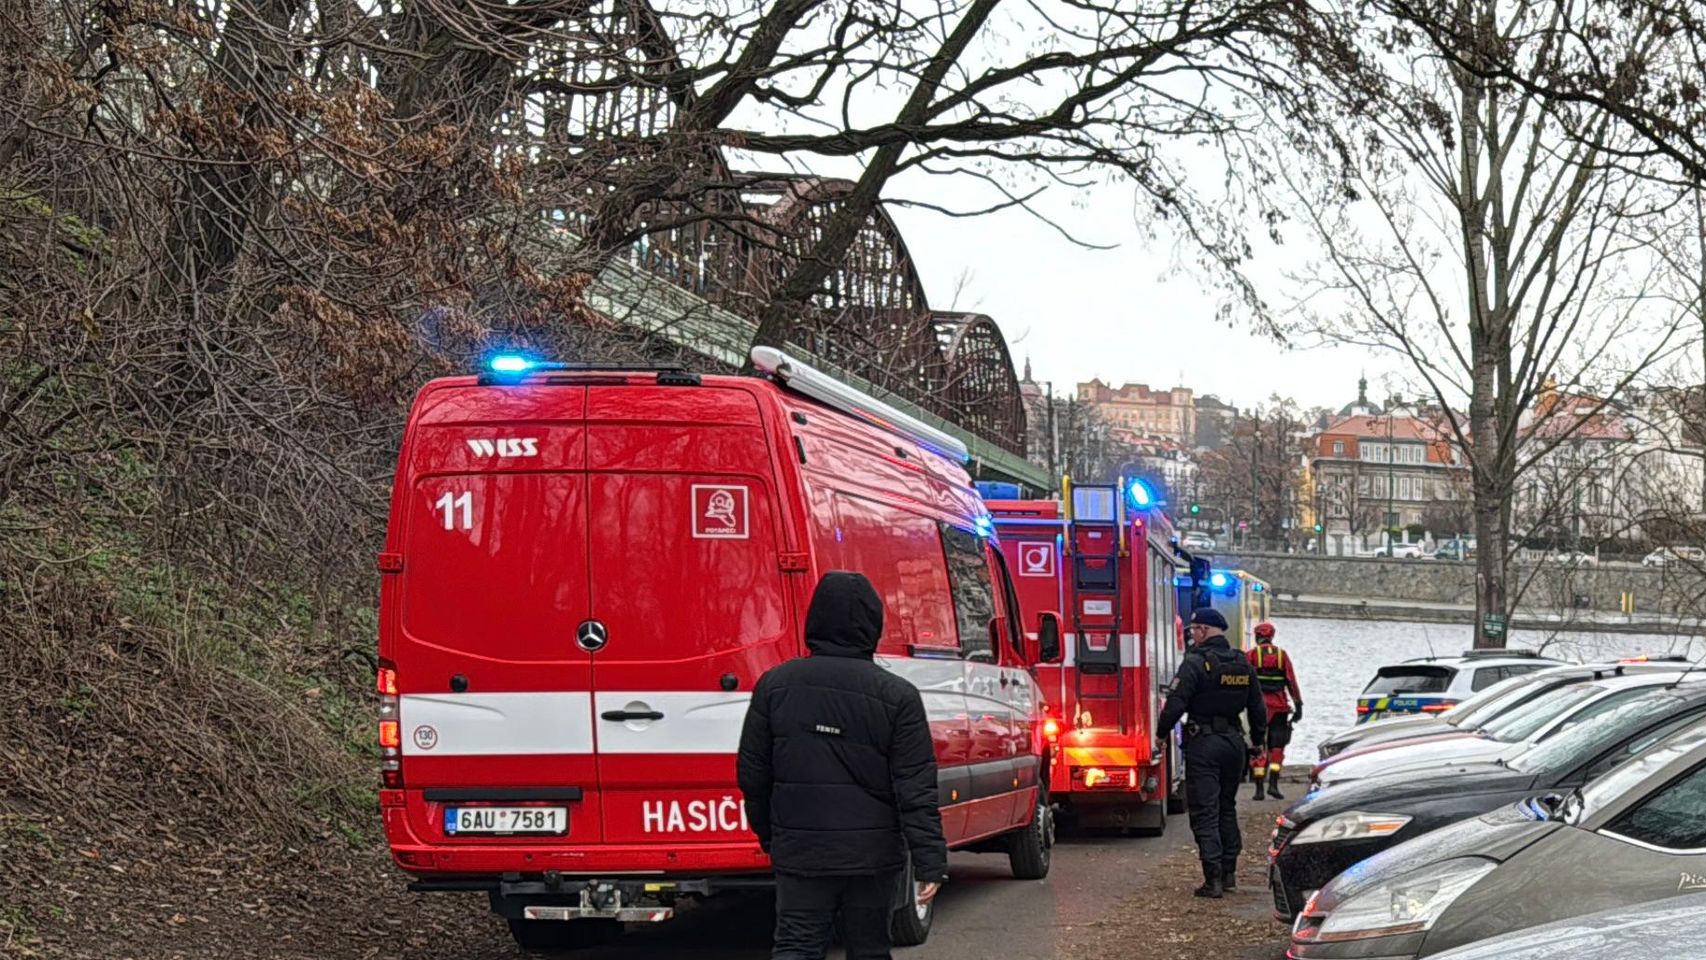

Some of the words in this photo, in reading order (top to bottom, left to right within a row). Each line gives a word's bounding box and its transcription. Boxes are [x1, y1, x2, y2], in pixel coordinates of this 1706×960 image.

[466, 438, 539, 458] WISS
[435, 490, 473, 531] 11
[1220, 674, 1250, 686] POLICIE
[461, 810, 495, 830] 6AU
[510, 810, 557, 830] 7581
